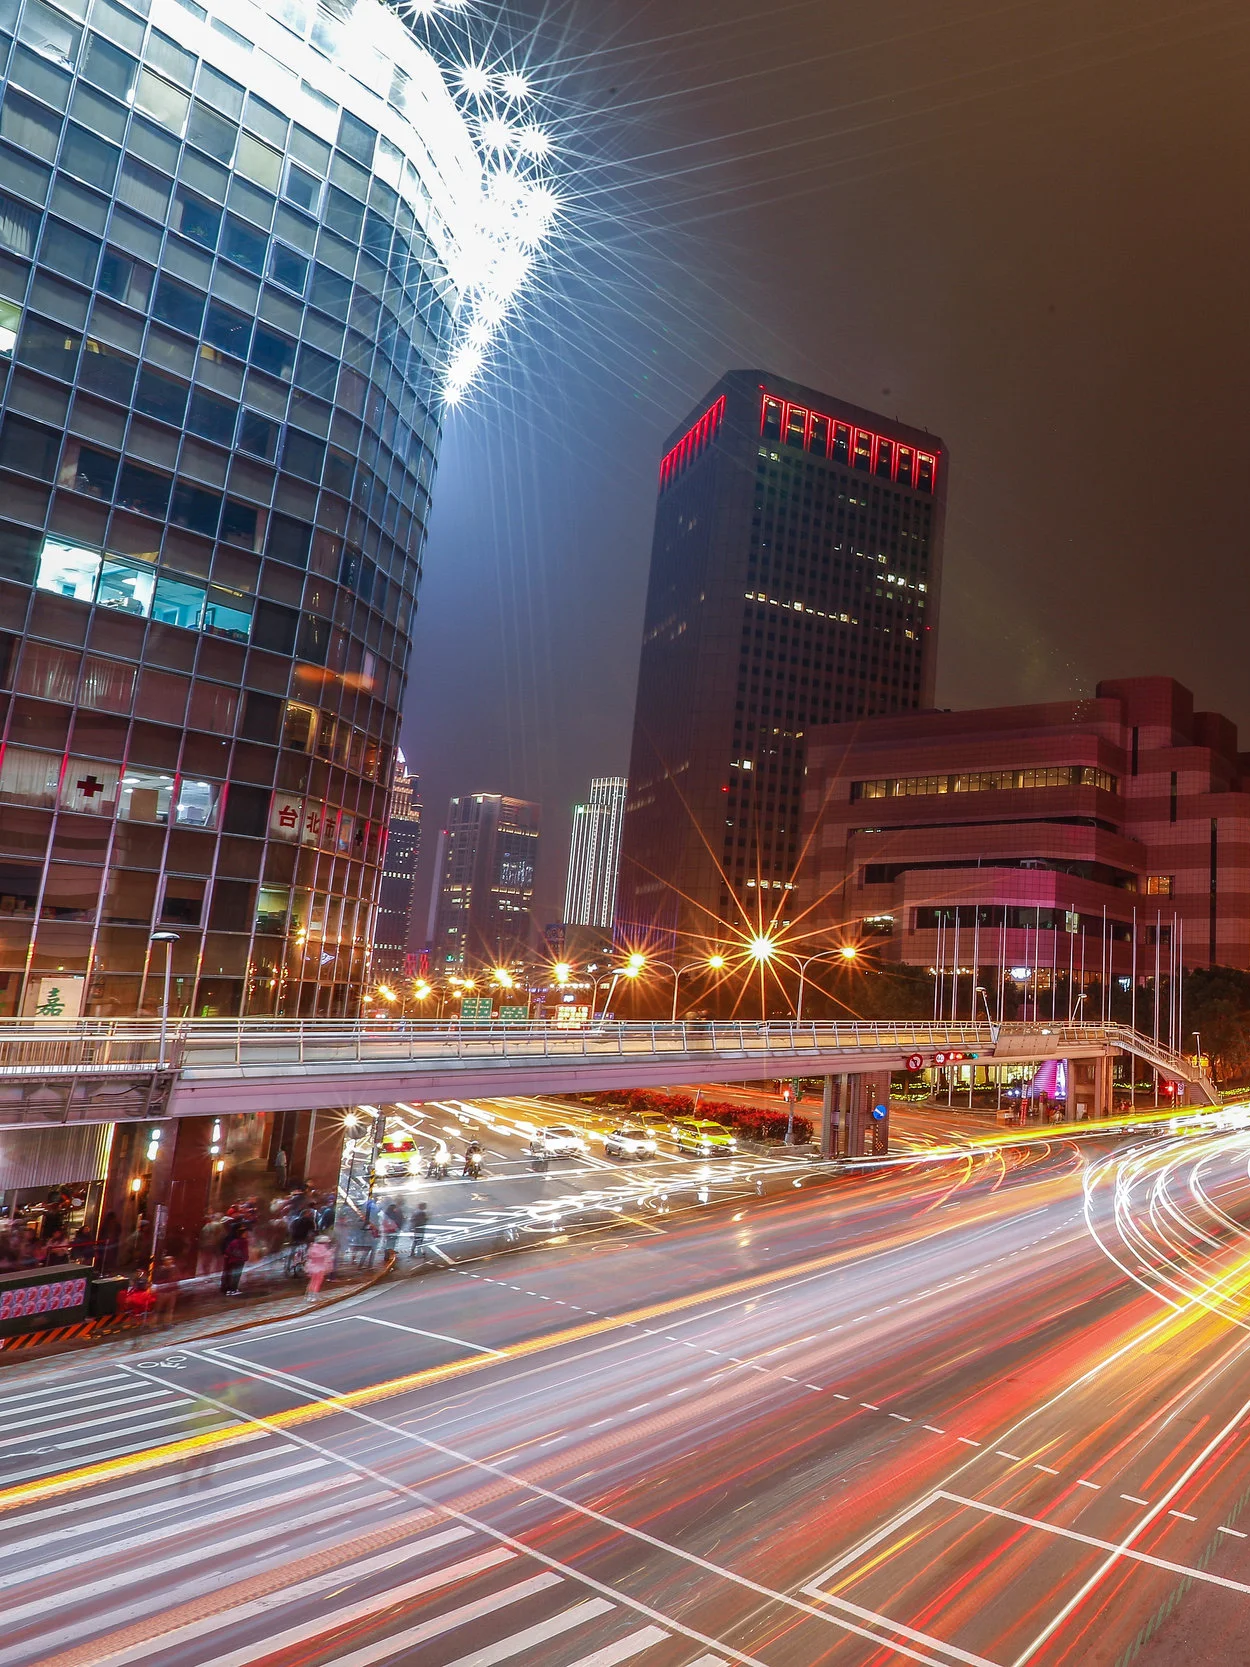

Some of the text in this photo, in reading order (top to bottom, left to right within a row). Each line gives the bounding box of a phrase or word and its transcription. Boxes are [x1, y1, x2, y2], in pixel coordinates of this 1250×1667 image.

[278, 805, 336, 839] 台北市
[35, 987, 65, 1016] 嘉
